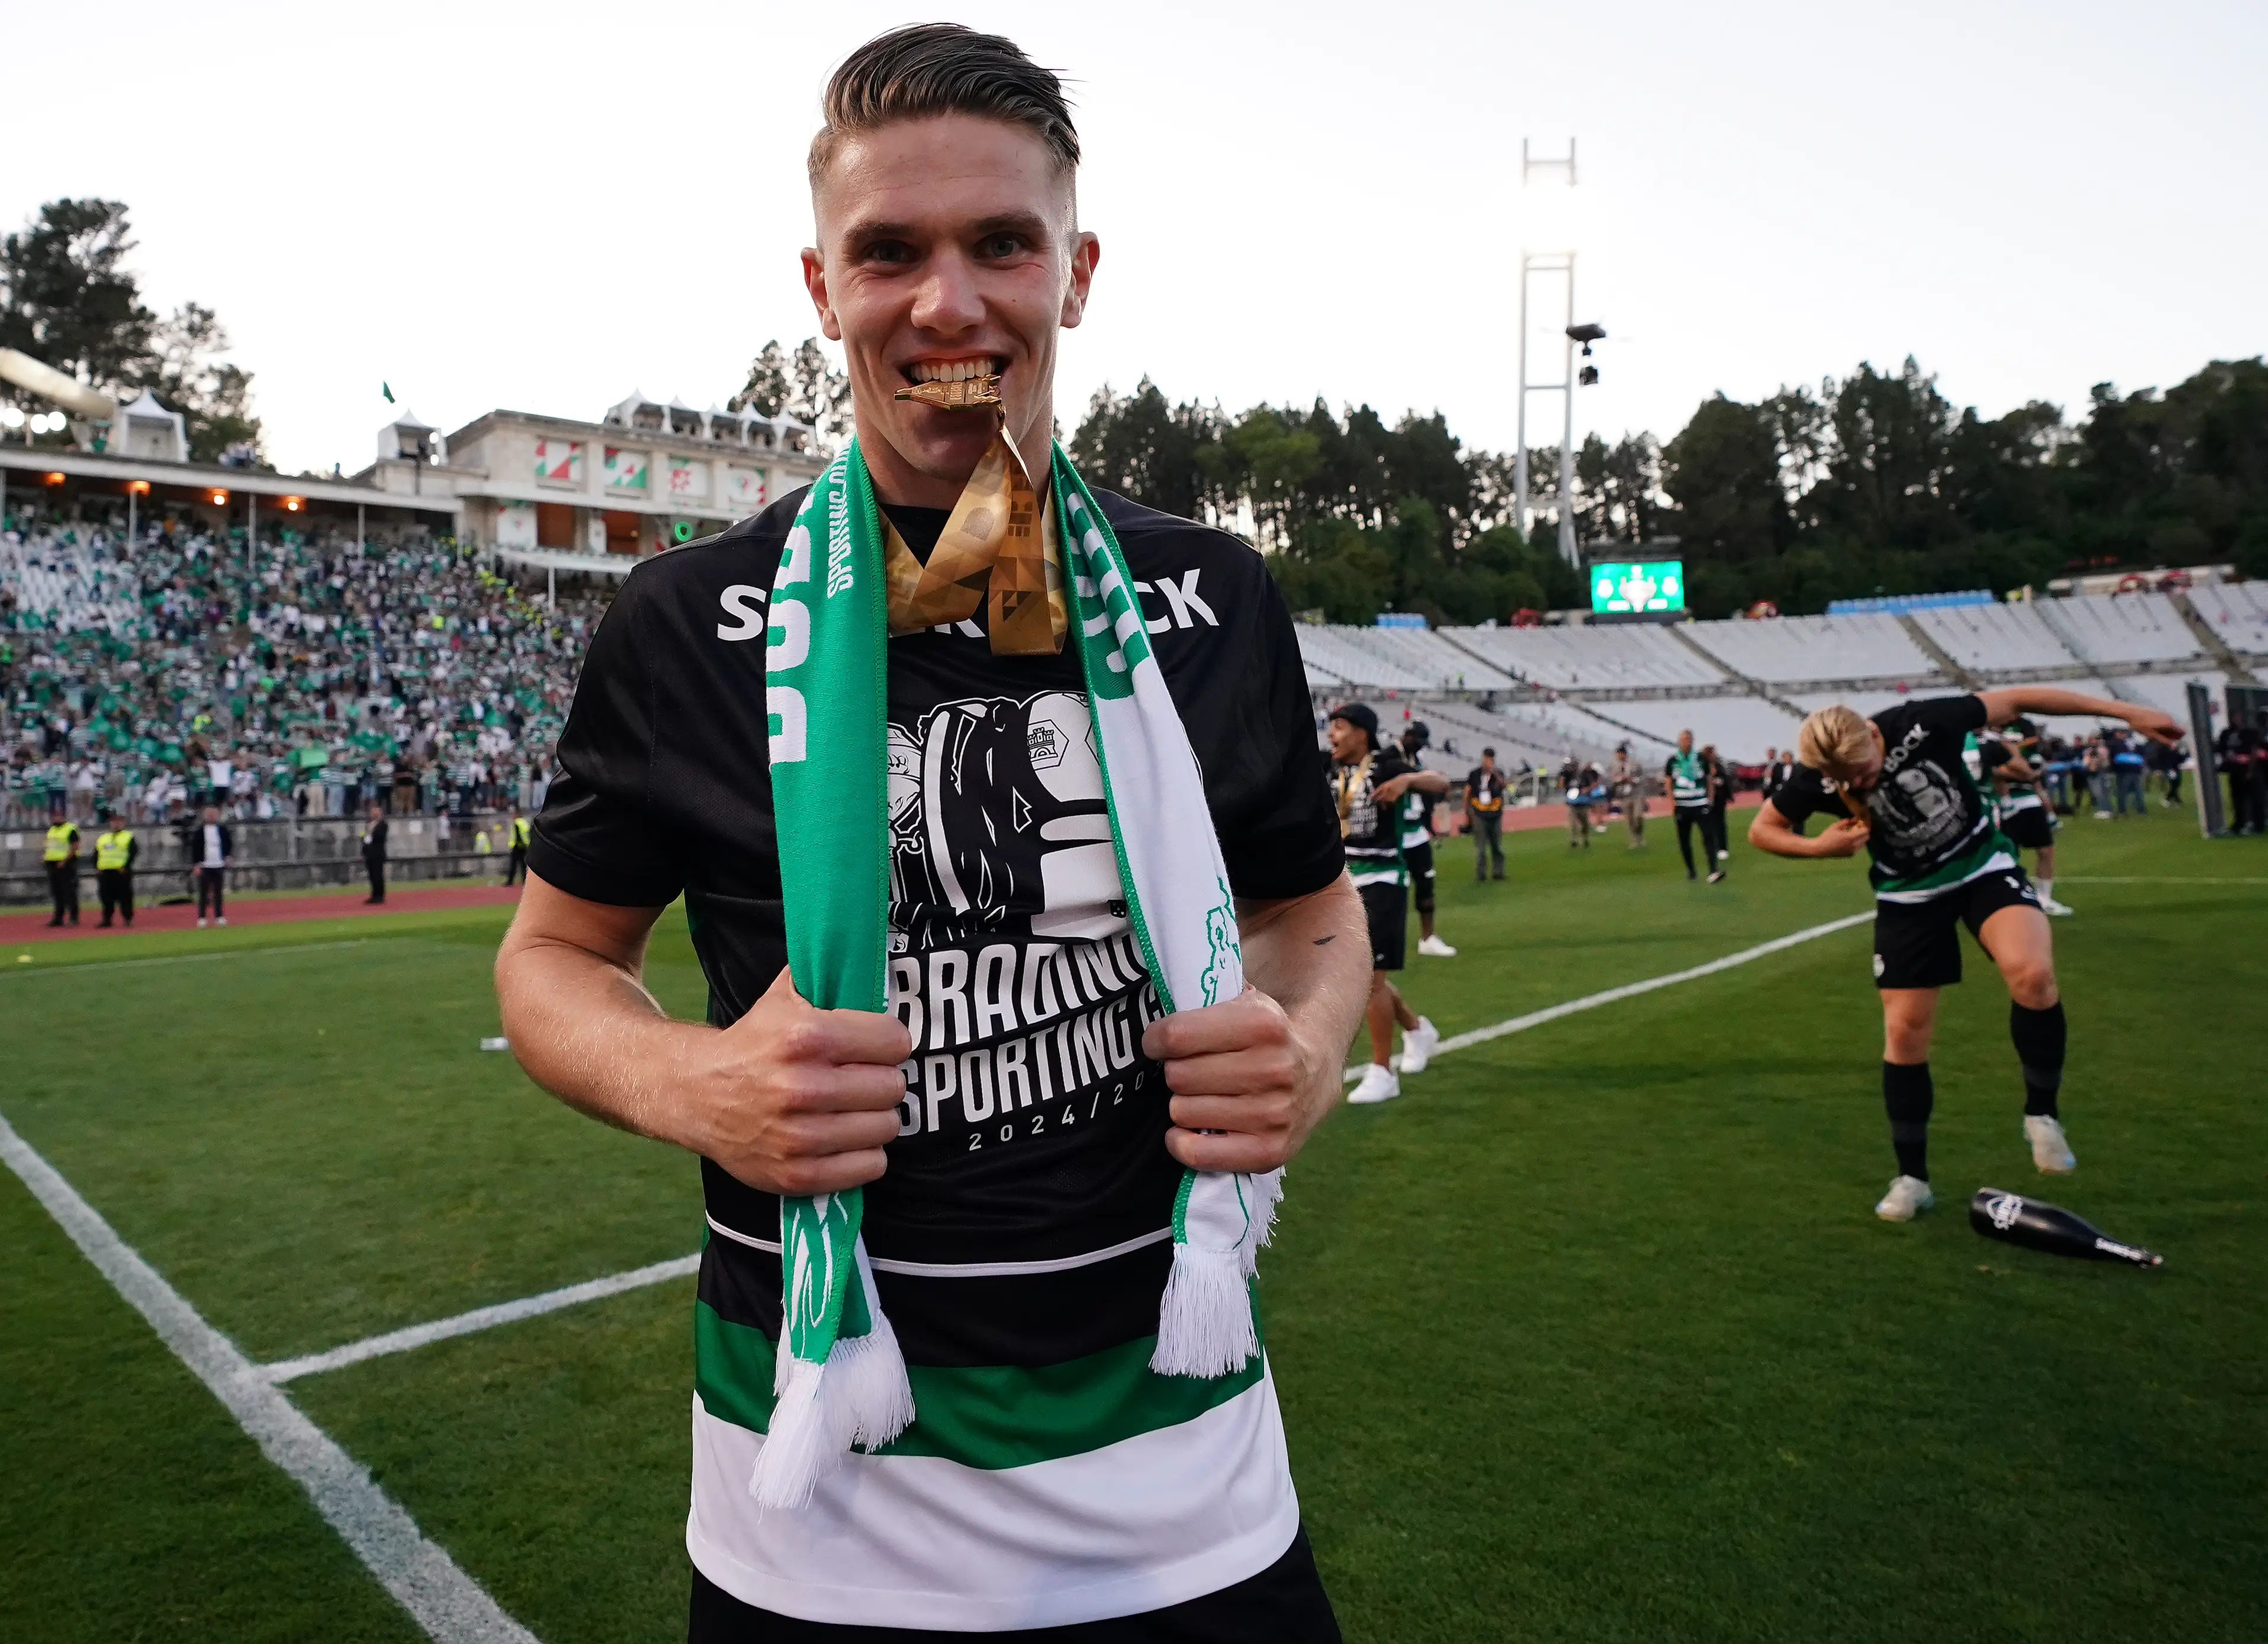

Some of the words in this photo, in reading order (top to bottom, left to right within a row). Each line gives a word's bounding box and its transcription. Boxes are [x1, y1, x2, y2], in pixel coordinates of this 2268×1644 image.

[1132, 568, 1220, 635] CK
[897, 995, 1135, 1137] SPORTING
[969, 1062, 1164, 1152] 2024/20
